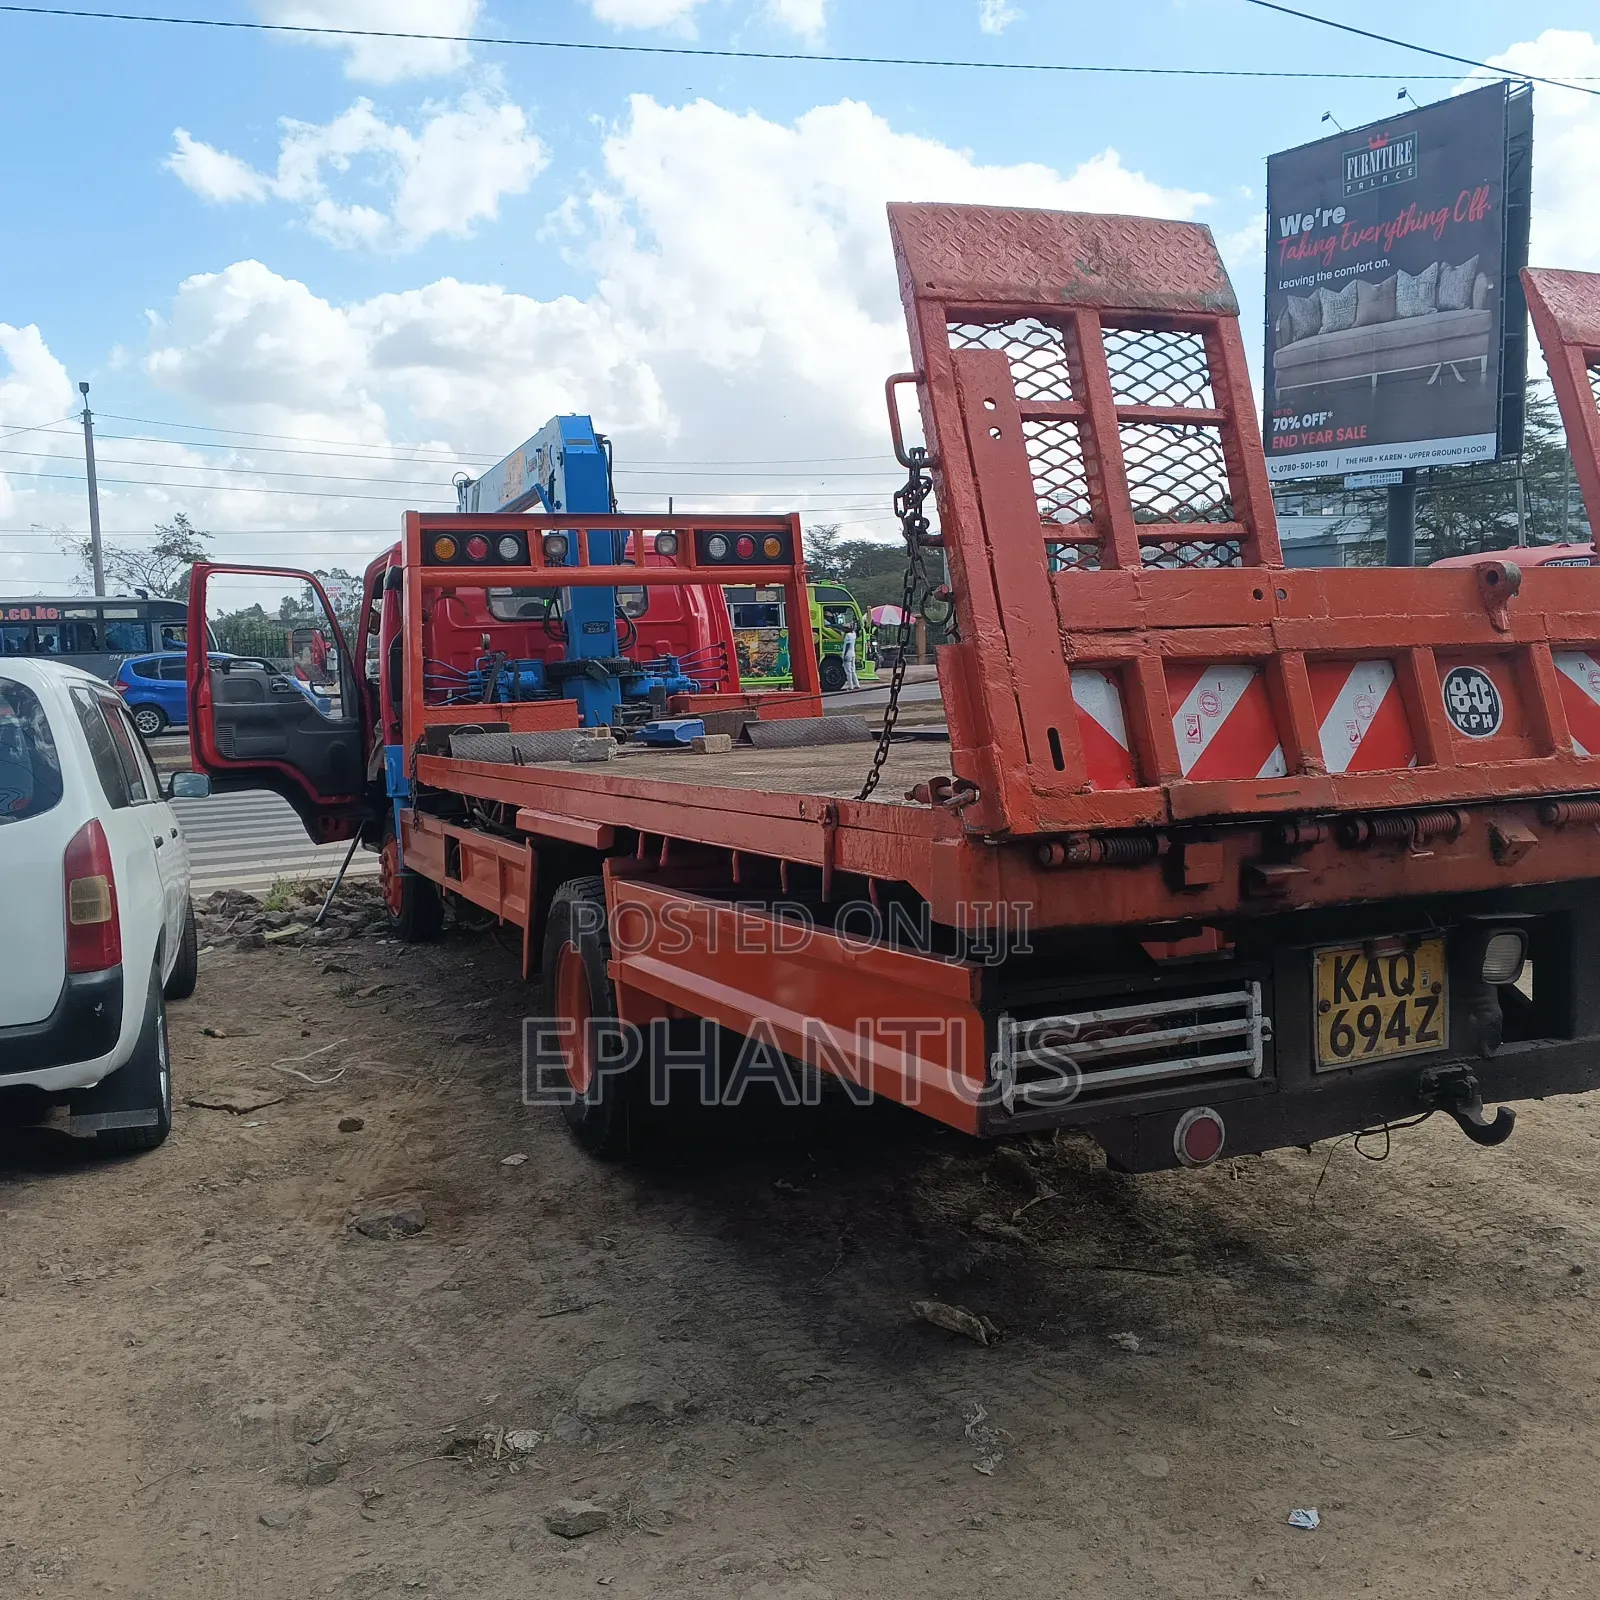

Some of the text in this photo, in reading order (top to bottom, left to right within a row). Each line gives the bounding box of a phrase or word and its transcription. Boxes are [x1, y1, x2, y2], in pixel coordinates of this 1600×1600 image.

[1346, 139, 1413, 180] FURNITURE
[1346, 167, 1413, 193] PALACE
[1277, 230, 1339, 266] Taking
[1340, 201, 1450, 252] Everything
[1278, 258, 1391, 290] Leaving the comfort on.
[1272, 408, 1293, 417] UP TO
[1272, 415, 1301, 432] 70%
[1272, 424, 1367, 449] END YEAR SALE
[1278, 460, 1328, 473] 0780-501-501
[1345, 445, 1487, 465] THE HUB KAREN UPPER GROUND FLOOR
[1217, 682, 1225, 692] L
[1449, 676, 1493, 713] 80
[1456, 714, 1494, 729] KPH
[1333, 951, 1416, 1005] KAQ
[1330, 995, 1440, 1058] 694Z
